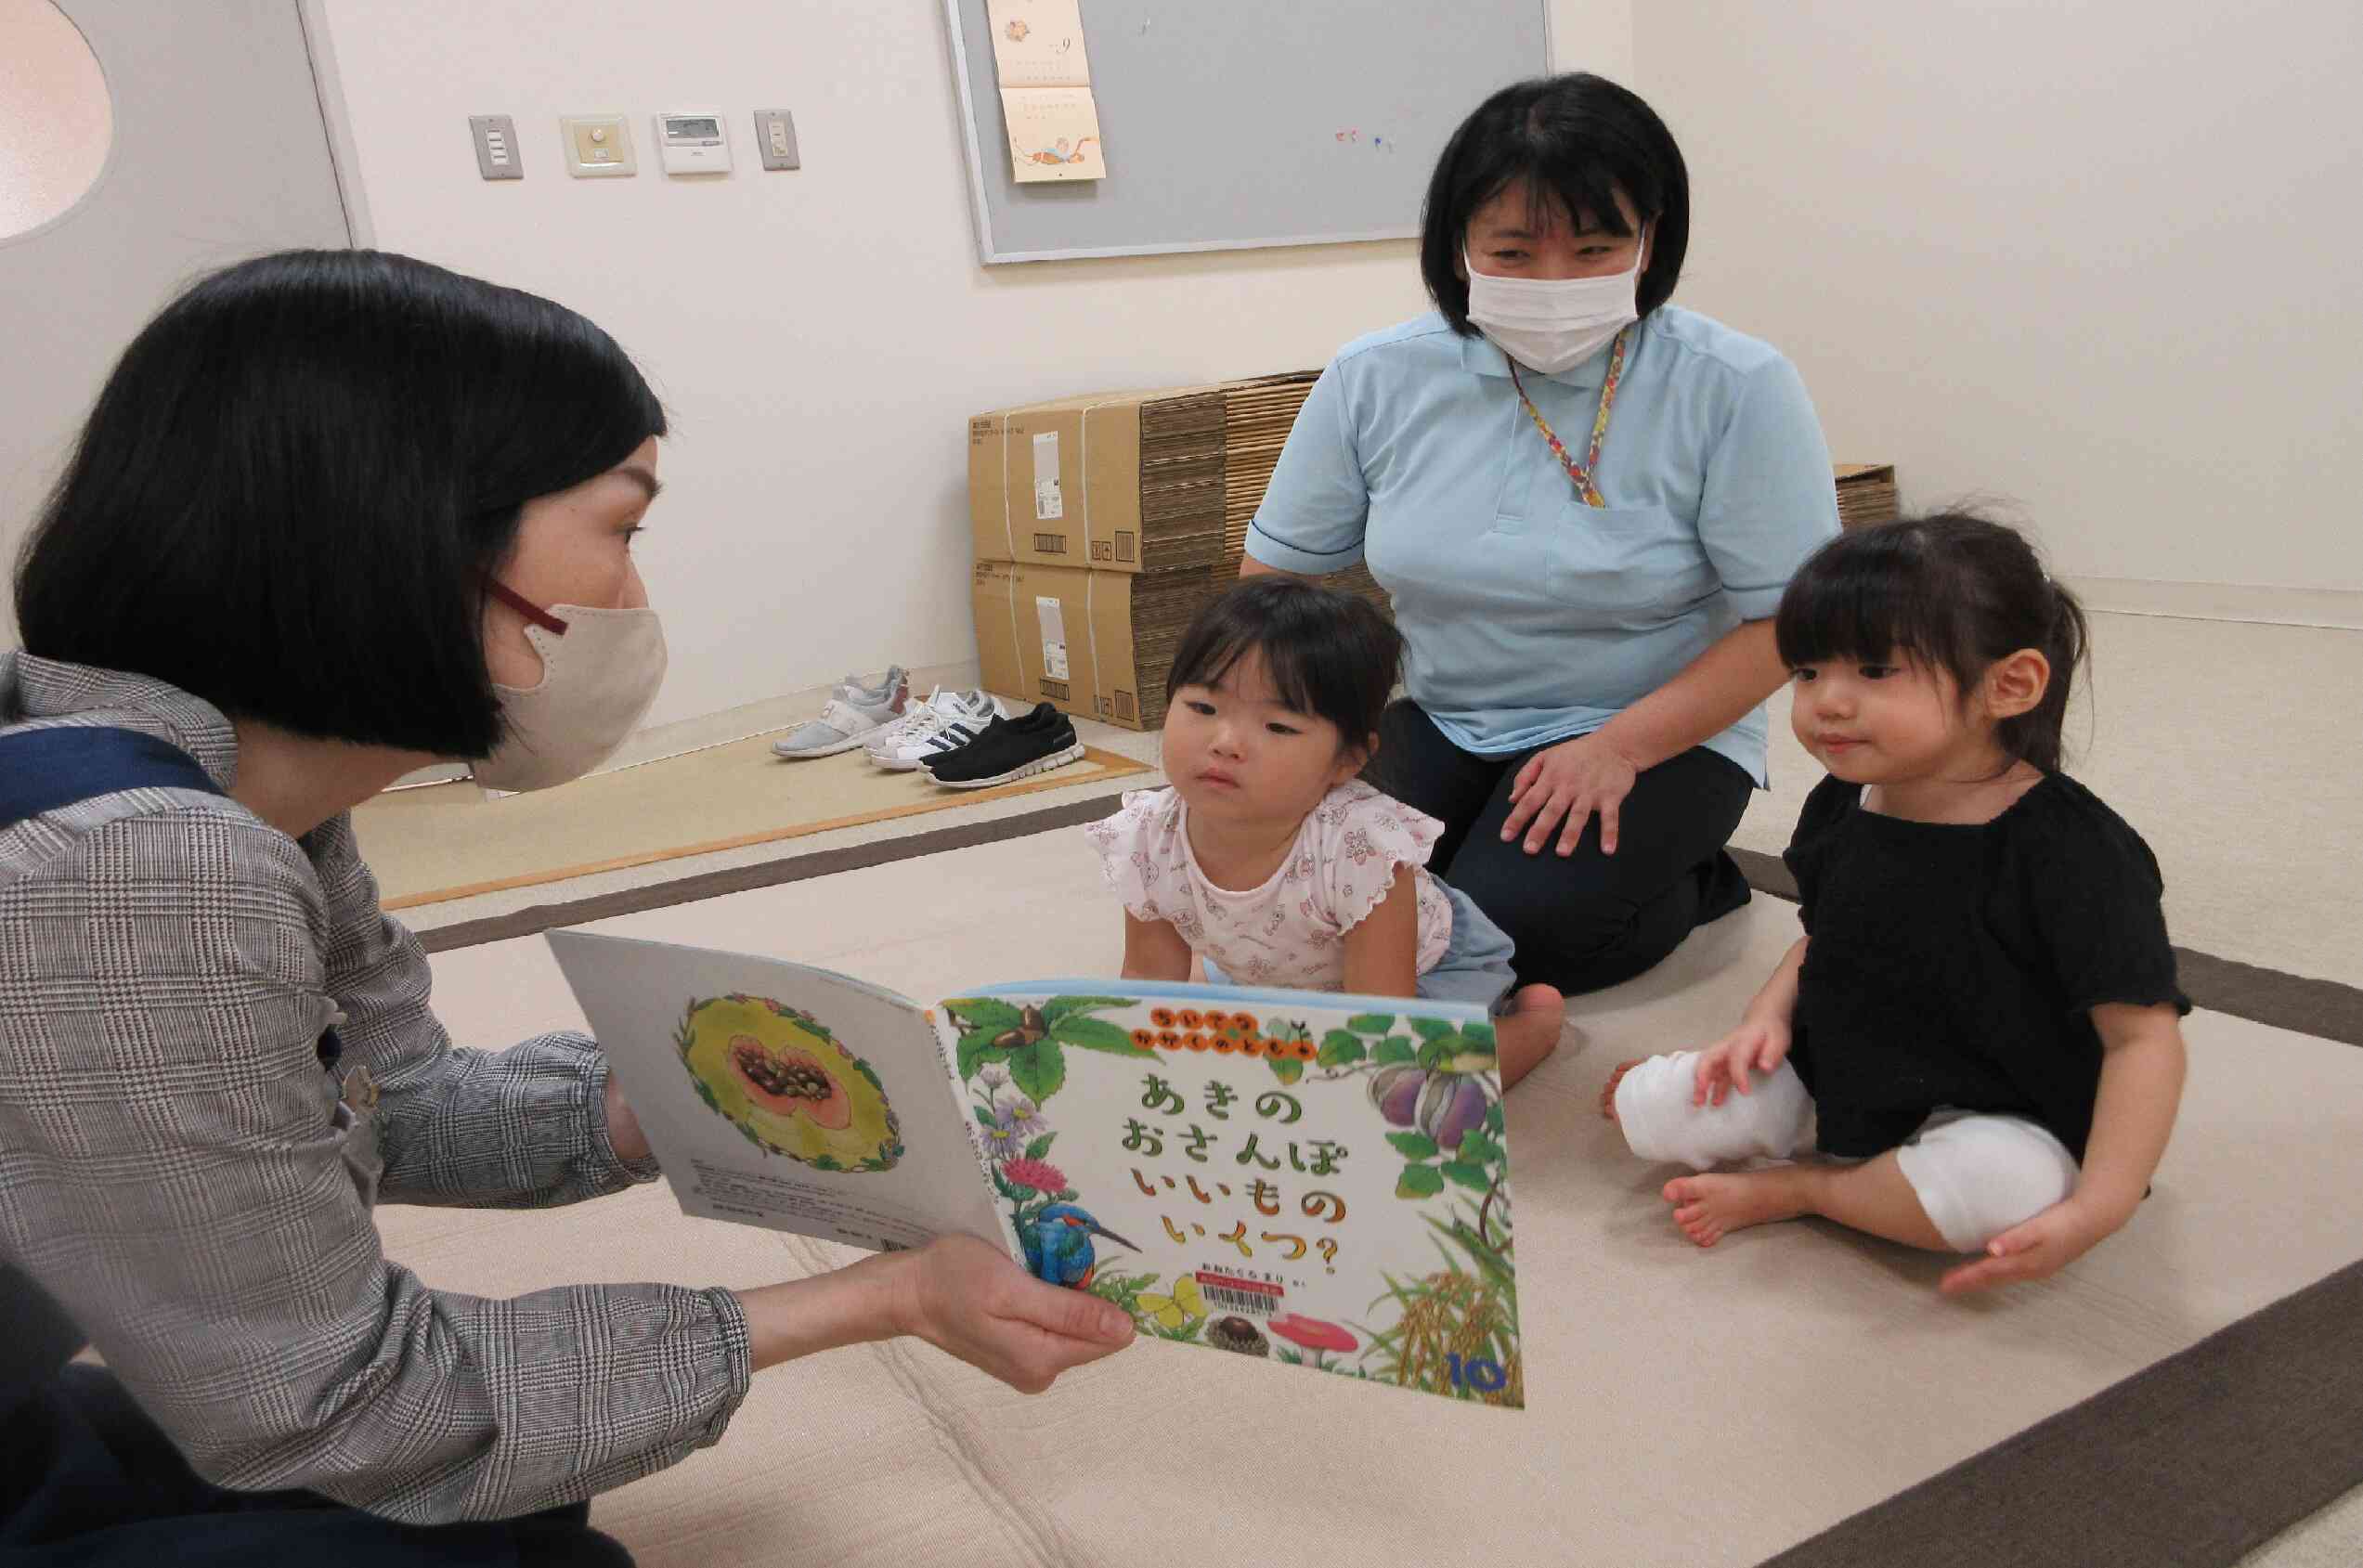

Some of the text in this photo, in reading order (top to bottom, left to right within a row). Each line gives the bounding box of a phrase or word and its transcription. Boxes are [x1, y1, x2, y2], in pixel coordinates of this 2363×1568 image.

[1141, 1073, 1302, 1123] あきの
[1122, 1117, 1348, 1175] おさんぽ
[1130, 1168, 1346, 1224] いいもの
[1446, 1352, 1506, 1392] 10
